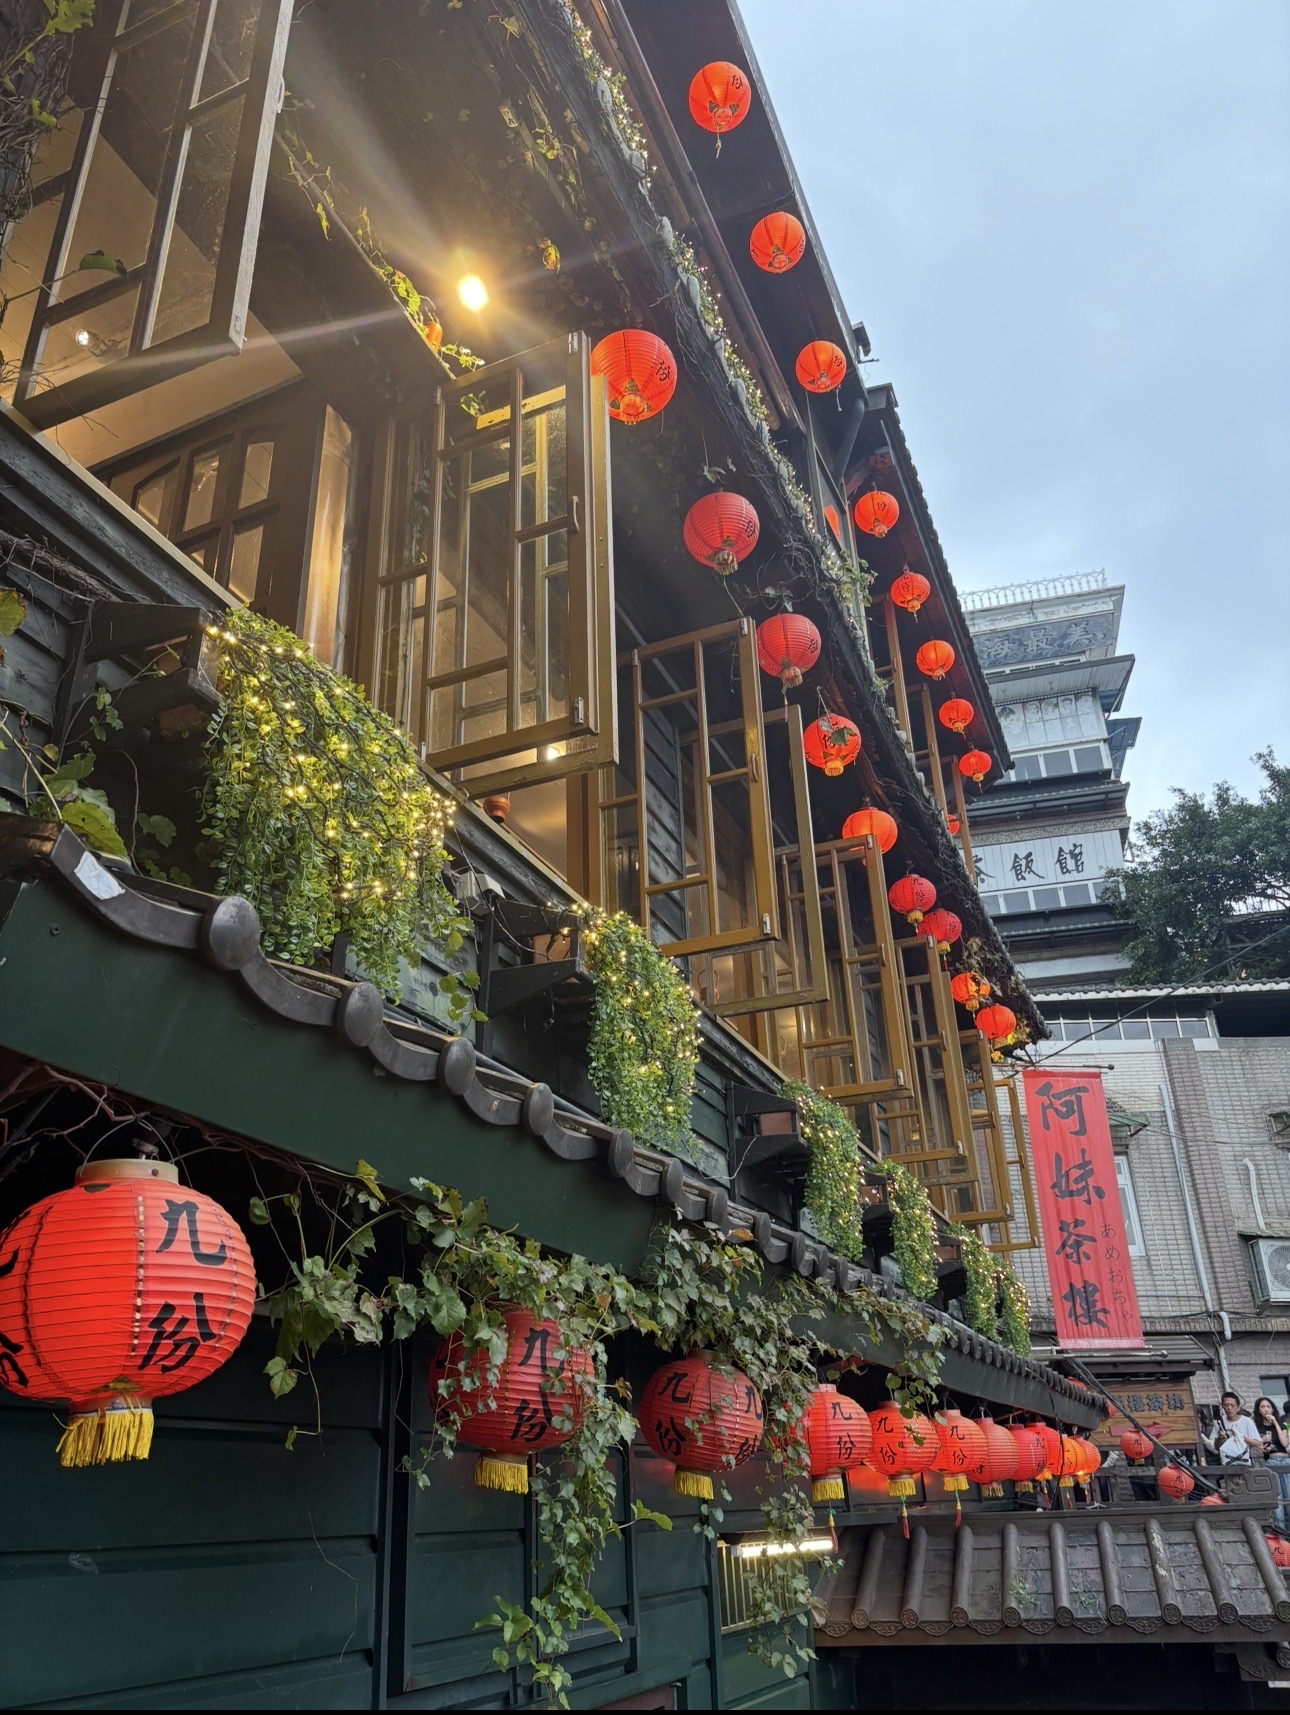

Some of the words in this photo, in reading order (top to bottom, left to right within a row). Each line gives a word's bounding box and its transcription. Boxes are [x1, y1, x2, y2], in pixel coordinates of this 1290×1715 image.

[1034, 1080, 1110, 1329] 阿妹茶樓
[137, 1198, 228, 1375] 九份
[1100, 1222, 1134, 1323] あめおちゃ
[510, 1327, 566, 1444] 九份
[655, 1371, 692, 1457] 九份
[831, 1401, 857, 1461] 九份
[876, 1416, 898, 1466] 九份
[949, 1425, 968, 1466] 九份
